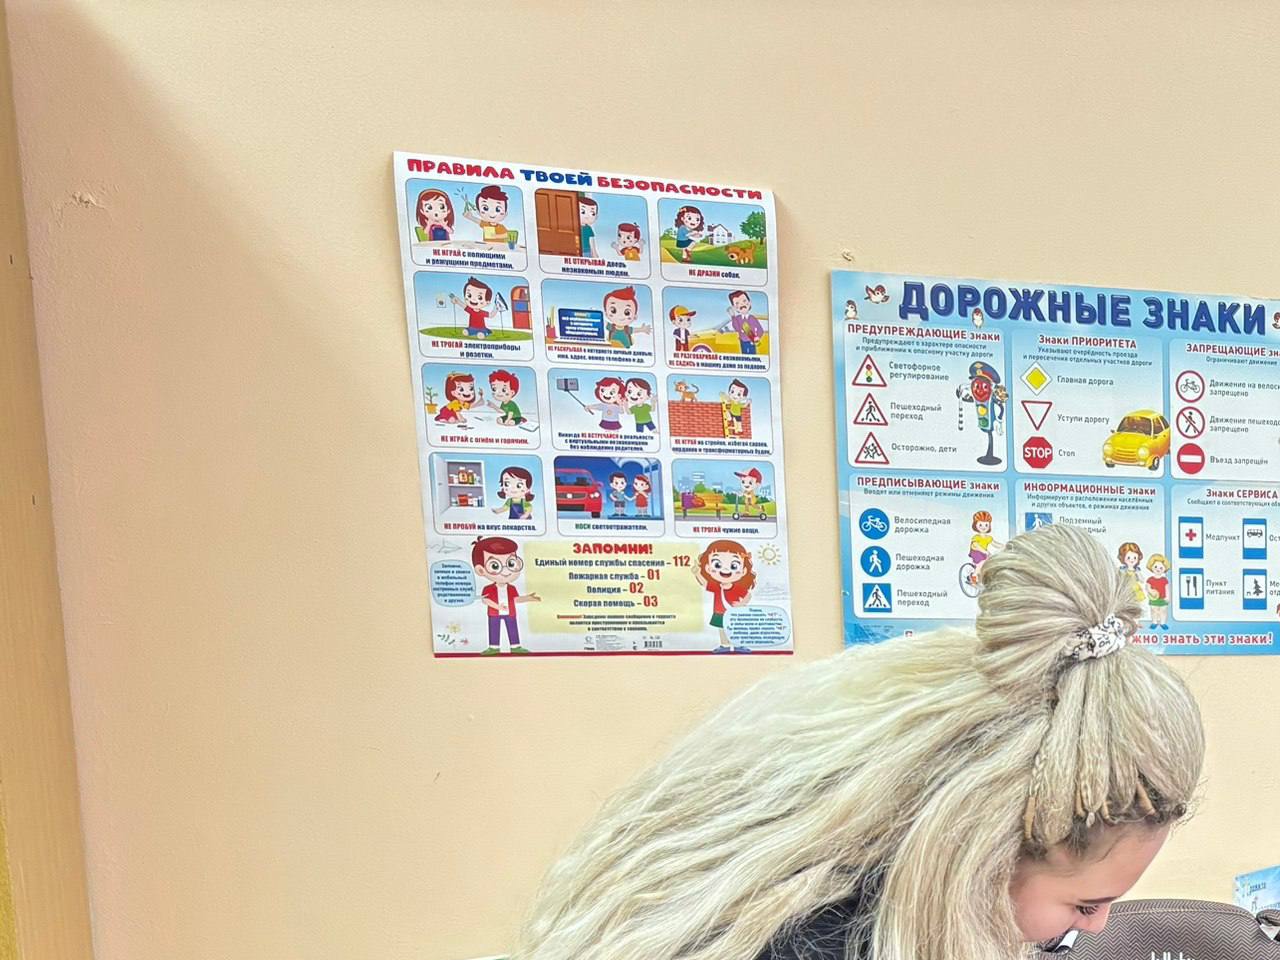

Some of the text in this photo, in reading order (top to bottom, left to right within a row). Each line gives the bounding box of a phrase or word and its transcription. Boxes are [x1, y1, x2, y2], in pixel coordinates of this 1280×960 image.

[407, 159, 763, 200] ПРАВИЛА ТВОЕЙ БЕЗОПАСНОСТИ
[572, 258, 606, 266] ОТКРЫВАЙ
[899, 281, 1266, 336] ДОРОЖНЫЕ ЗНАКИ
[847, 324, 1000, 342] ПРЕДУПРЕЖДАЮЩИЕ знаки
[441, 340, 463, 349] ТРОГАЙ
[464, 343, 521, 352] электроприборы
[1039, 335, 1136, 348] Знаки ПРИОРИТЕТА
[1186, 343, 1266, 356] ЗАПРЕЩАЮЩИЕ
[889, 362, 941, 372] Светофорное
[890, 372, 949, 381] регулирование
[1058, 376, 1113, 386] Главная дорога
[1210, 380, 1246, 389] Движение
[890, 402, 942, 412] Пешеходный
[1057, 414, 1110, 424] Уступи дорогу
[1210, 416, 1248, 424] Движение
[892, 443, 937, 452] Осторожно,
[1024, 447, 1052, 458] STOP
[1210, 456, 1268, 466] Въезд запрещён
[857, 477, 999, 491] ПРЕДПИСЫВАЮЩИЕ знаки
[1024, 483, 1156, 496] ИНФОРМАЦИОННЫЕ знаки
[1206, 489, 1278, 499] Знаки СЕРВИСА
[894, 517, 951, 525] Велосипедная
[894, 527, 929, 535] дорожка
[573, 543, 653, 554] ЗАПОМНИ!
[535, 558, 567, 566] Единый
[595, 559, 627, 567] службы
[672, 556, 690, 567] 112
[896, 554, 944, 562] Пешеходная
[647, 569, 660, 580] 01
[629, 582, 644, 593] 02
[897, 590, 948, 598] Пешеходный
[644, 596, 658, 607] 03
[1164, 634, 1199, 644] знать
[1204, 634, 1225, 644] эти
[1228, 633, 1273, 644] знаки!
